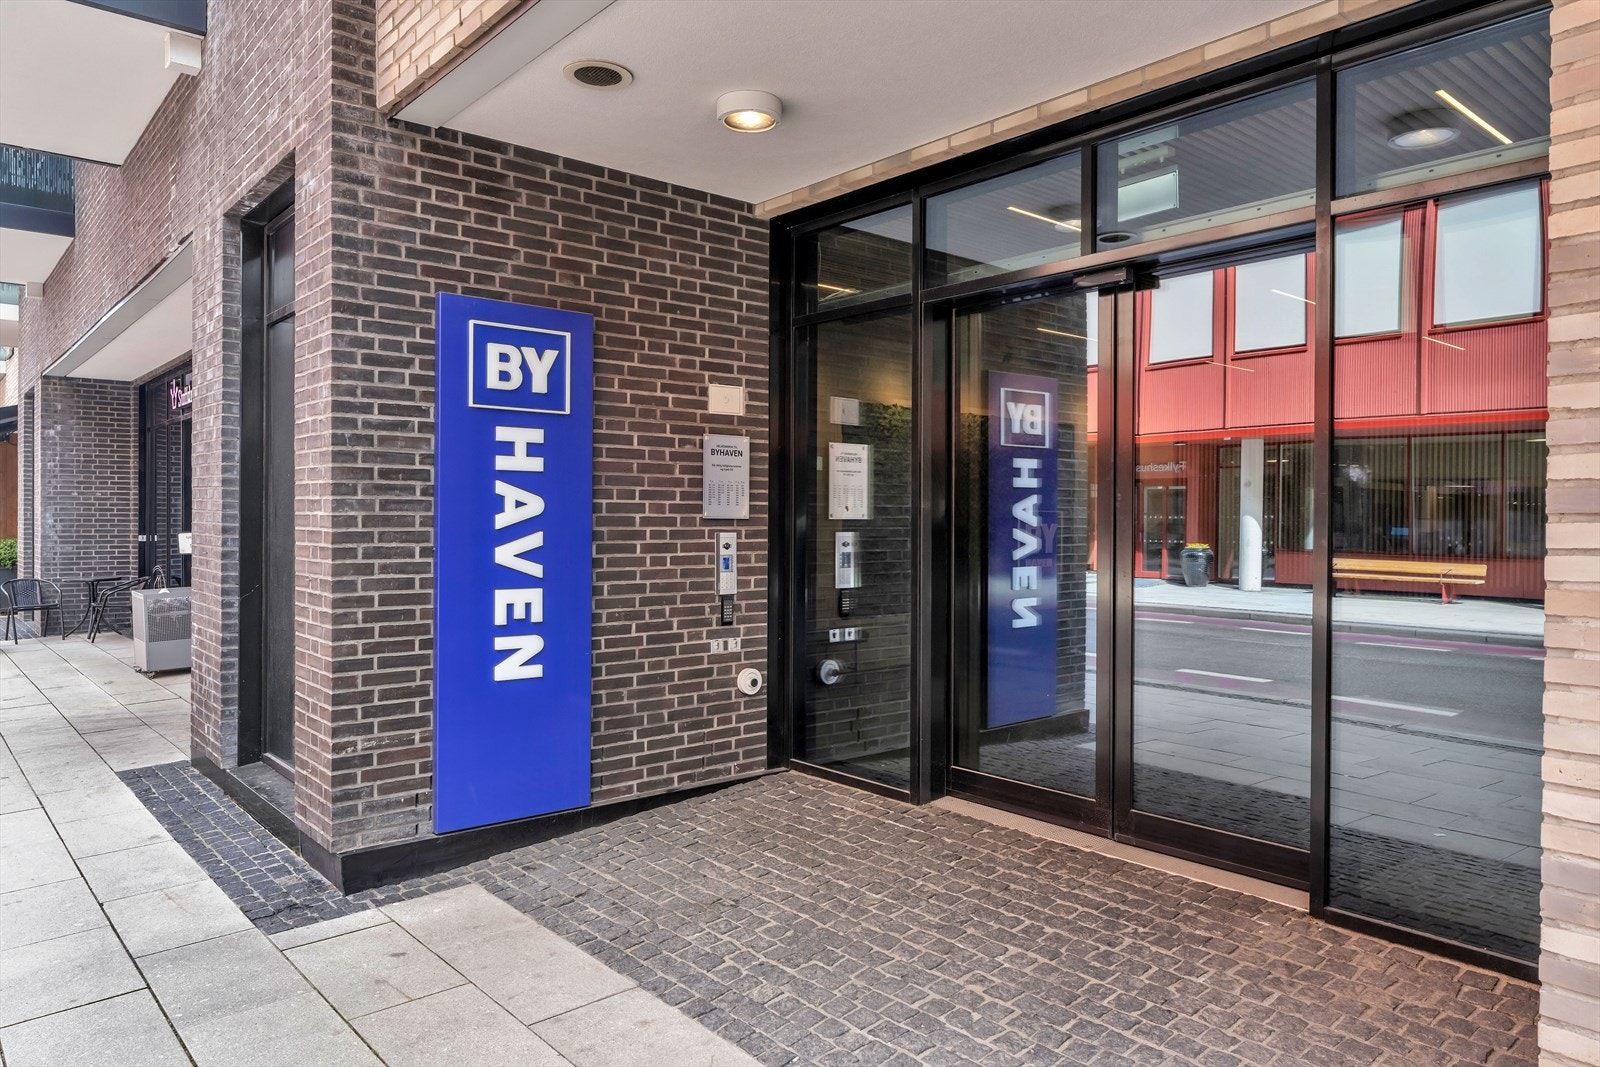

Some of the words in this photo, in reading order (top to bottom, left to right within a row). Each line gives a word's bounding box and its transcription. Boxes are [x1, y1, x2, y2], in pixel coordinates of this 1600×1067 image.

[486, 342, 559, 394] BY
[711, 448, 743, 457] BYHAVEN
[494, 426, 546, 682] HAVEN
